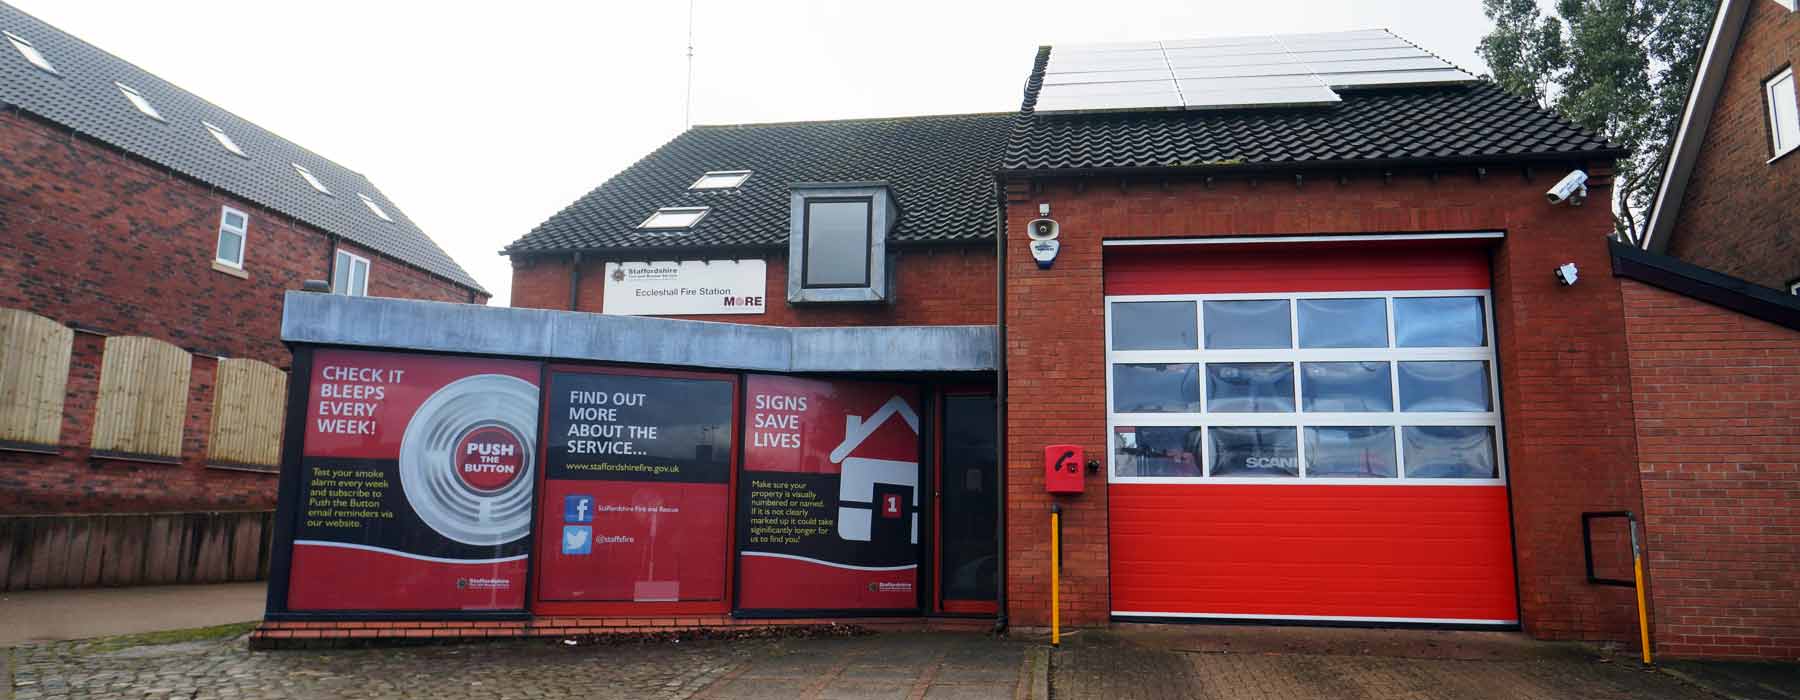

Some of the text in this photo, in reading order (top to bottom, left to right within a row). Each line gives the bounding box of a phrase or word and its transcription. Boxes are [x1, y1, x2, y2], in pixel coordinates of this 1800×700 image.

[628, 267, 678, 275] Staffordshire
[635, 287, 732, 297] Eccleshall Fire Station
[723, 296, 763, 307] MORE
[322, 366, 405, 384] CHECK IT
[320, 383, 385, 400] BLEEPS
[569, 390, 647, 407] FIND OUT
[755, 394, 808, 411] SIGNS
[319, 400, 377, 417] EVERY
[568, 407, 617, 422] MORE
[317, 418, 376, 435] WEEK!
[754, 413, 800, 429] SAVE
[567, 423, 657, 440] ABOUT THE
[754, 431, 801, 449] LIVES
[466, 442, 515, 456] PUSH
[567, 440, 647, 455] SERVICE...
[480, 455, 500, 464] THE
[312, 467, 384, 479] Test your smoke
[464, 463, 515, 473] BUTTON
[566, 462, 680, 474] www.staffordshirefire.gov.uk
[311, 478, 389, 489] alarm every week
[752, 480, 771, 489] Make
[790, 483, 807, 491] your
[310, 488, 382, 498] and subscribe to
[752, 491, 783, 499] property
[791, 491, 817, 501] visually
[309, 497, 380, 508] Push the Button
[752, 499, 789, 507] numbered
[887, 496, 897, 513] 1
[308, 508, 393, 518] email reminders via
[752, 507, 757, 515] If
[771, 508, 784, 516] not
[785, 508, 809, 519] clearly
[751, 516, 778, 525] marked
[780, 519, 789, 527] up
[797, 518, 817, 526] could
[751, 525, 829, 536] significantly longer for
[770, 535, 784, 543] find
